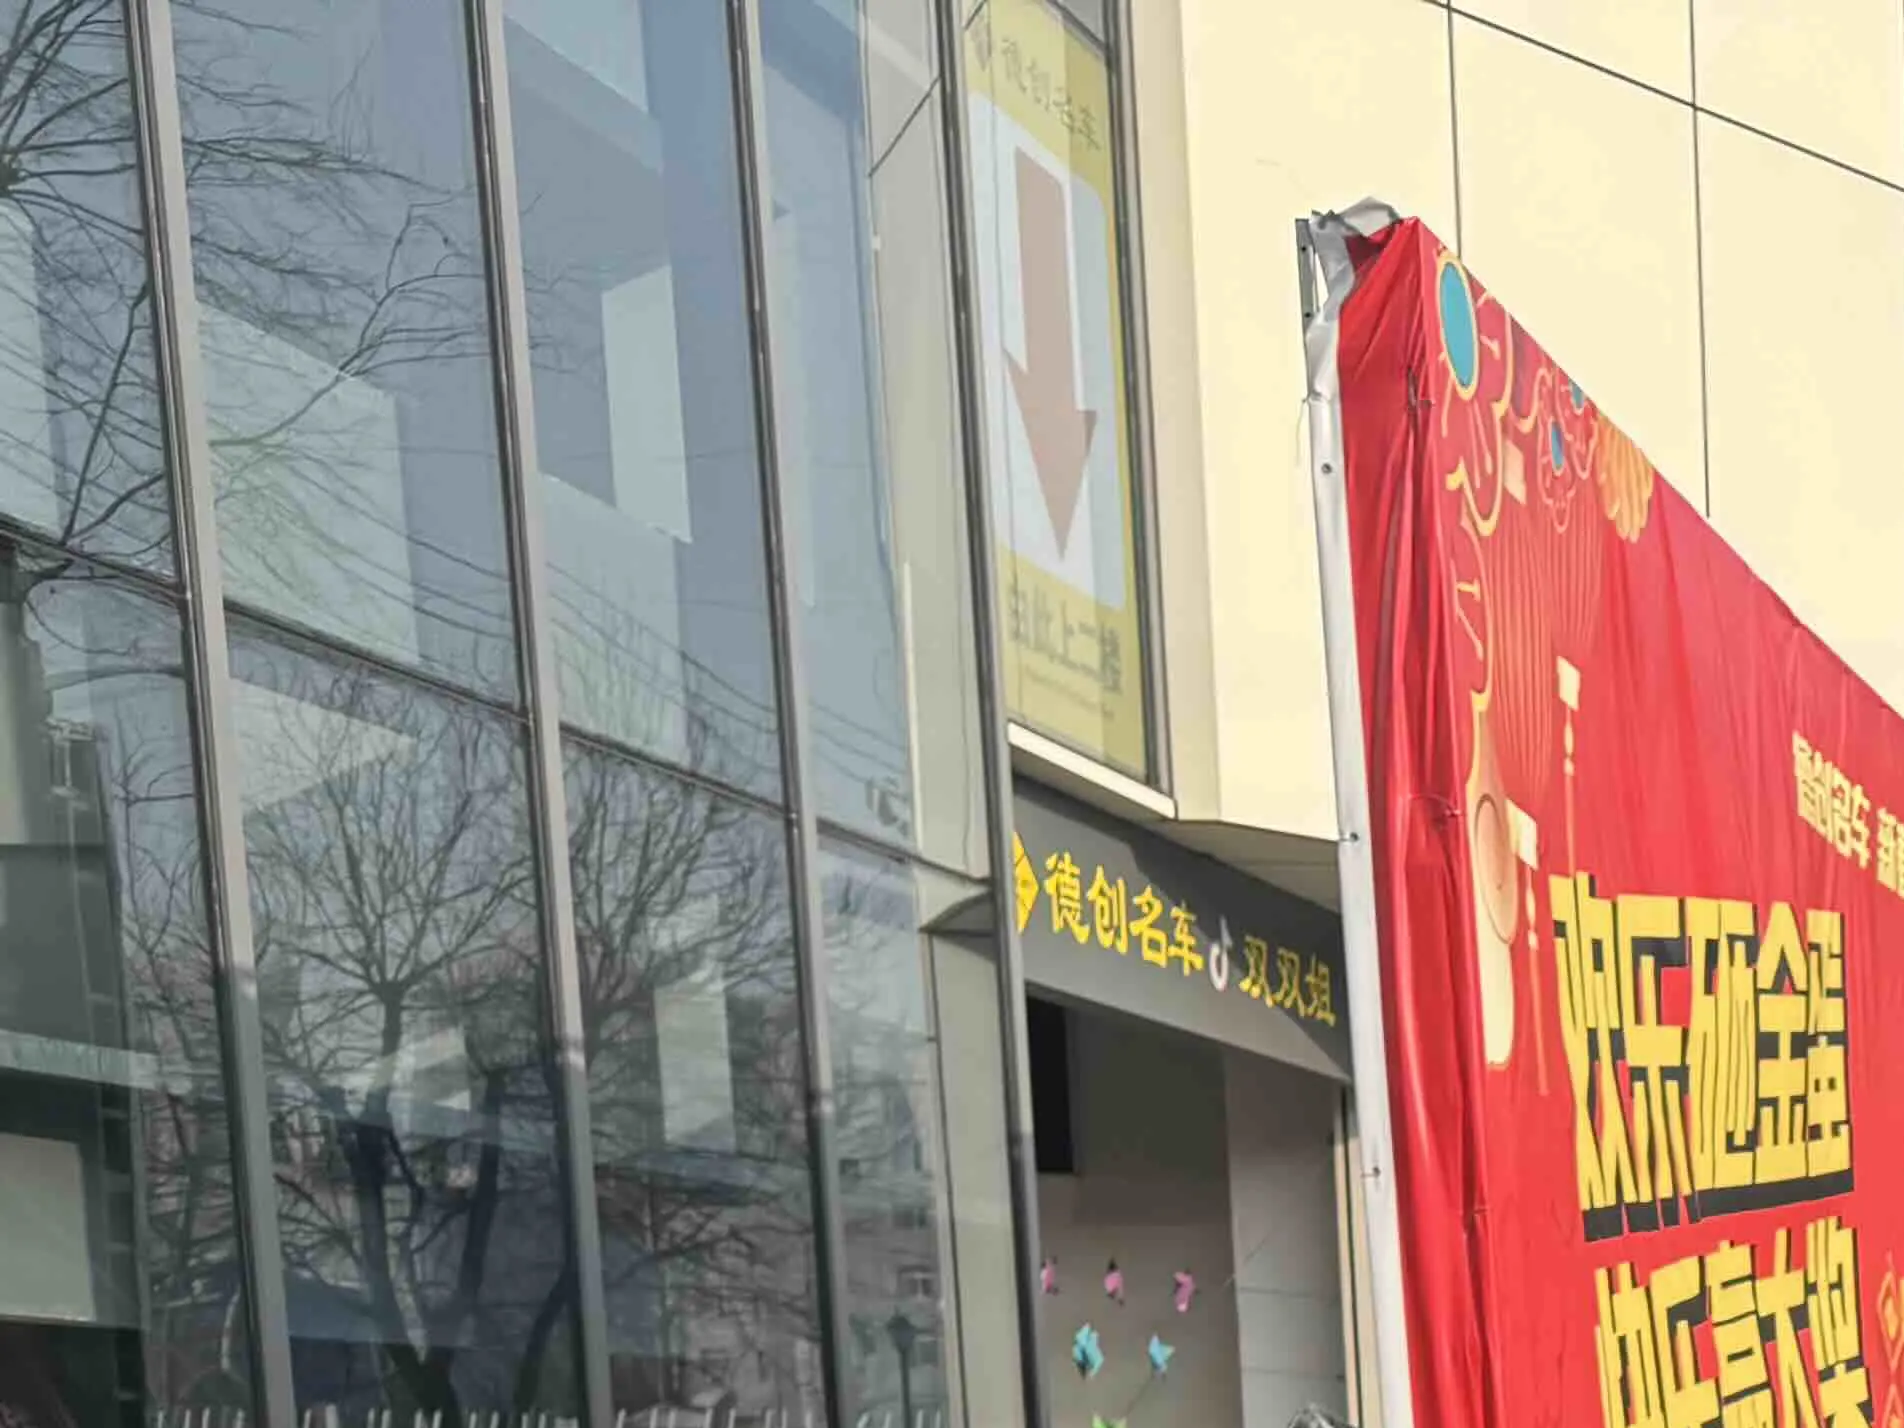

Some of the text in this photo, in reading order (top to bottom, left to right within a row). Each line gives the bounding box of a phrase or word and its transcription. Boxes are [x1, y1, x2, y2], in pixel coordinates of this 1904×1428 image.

[1044, 851, 1203, 976] 德创名车
[1549, 871, 1853, 1212] 欢乐砸金蛋
